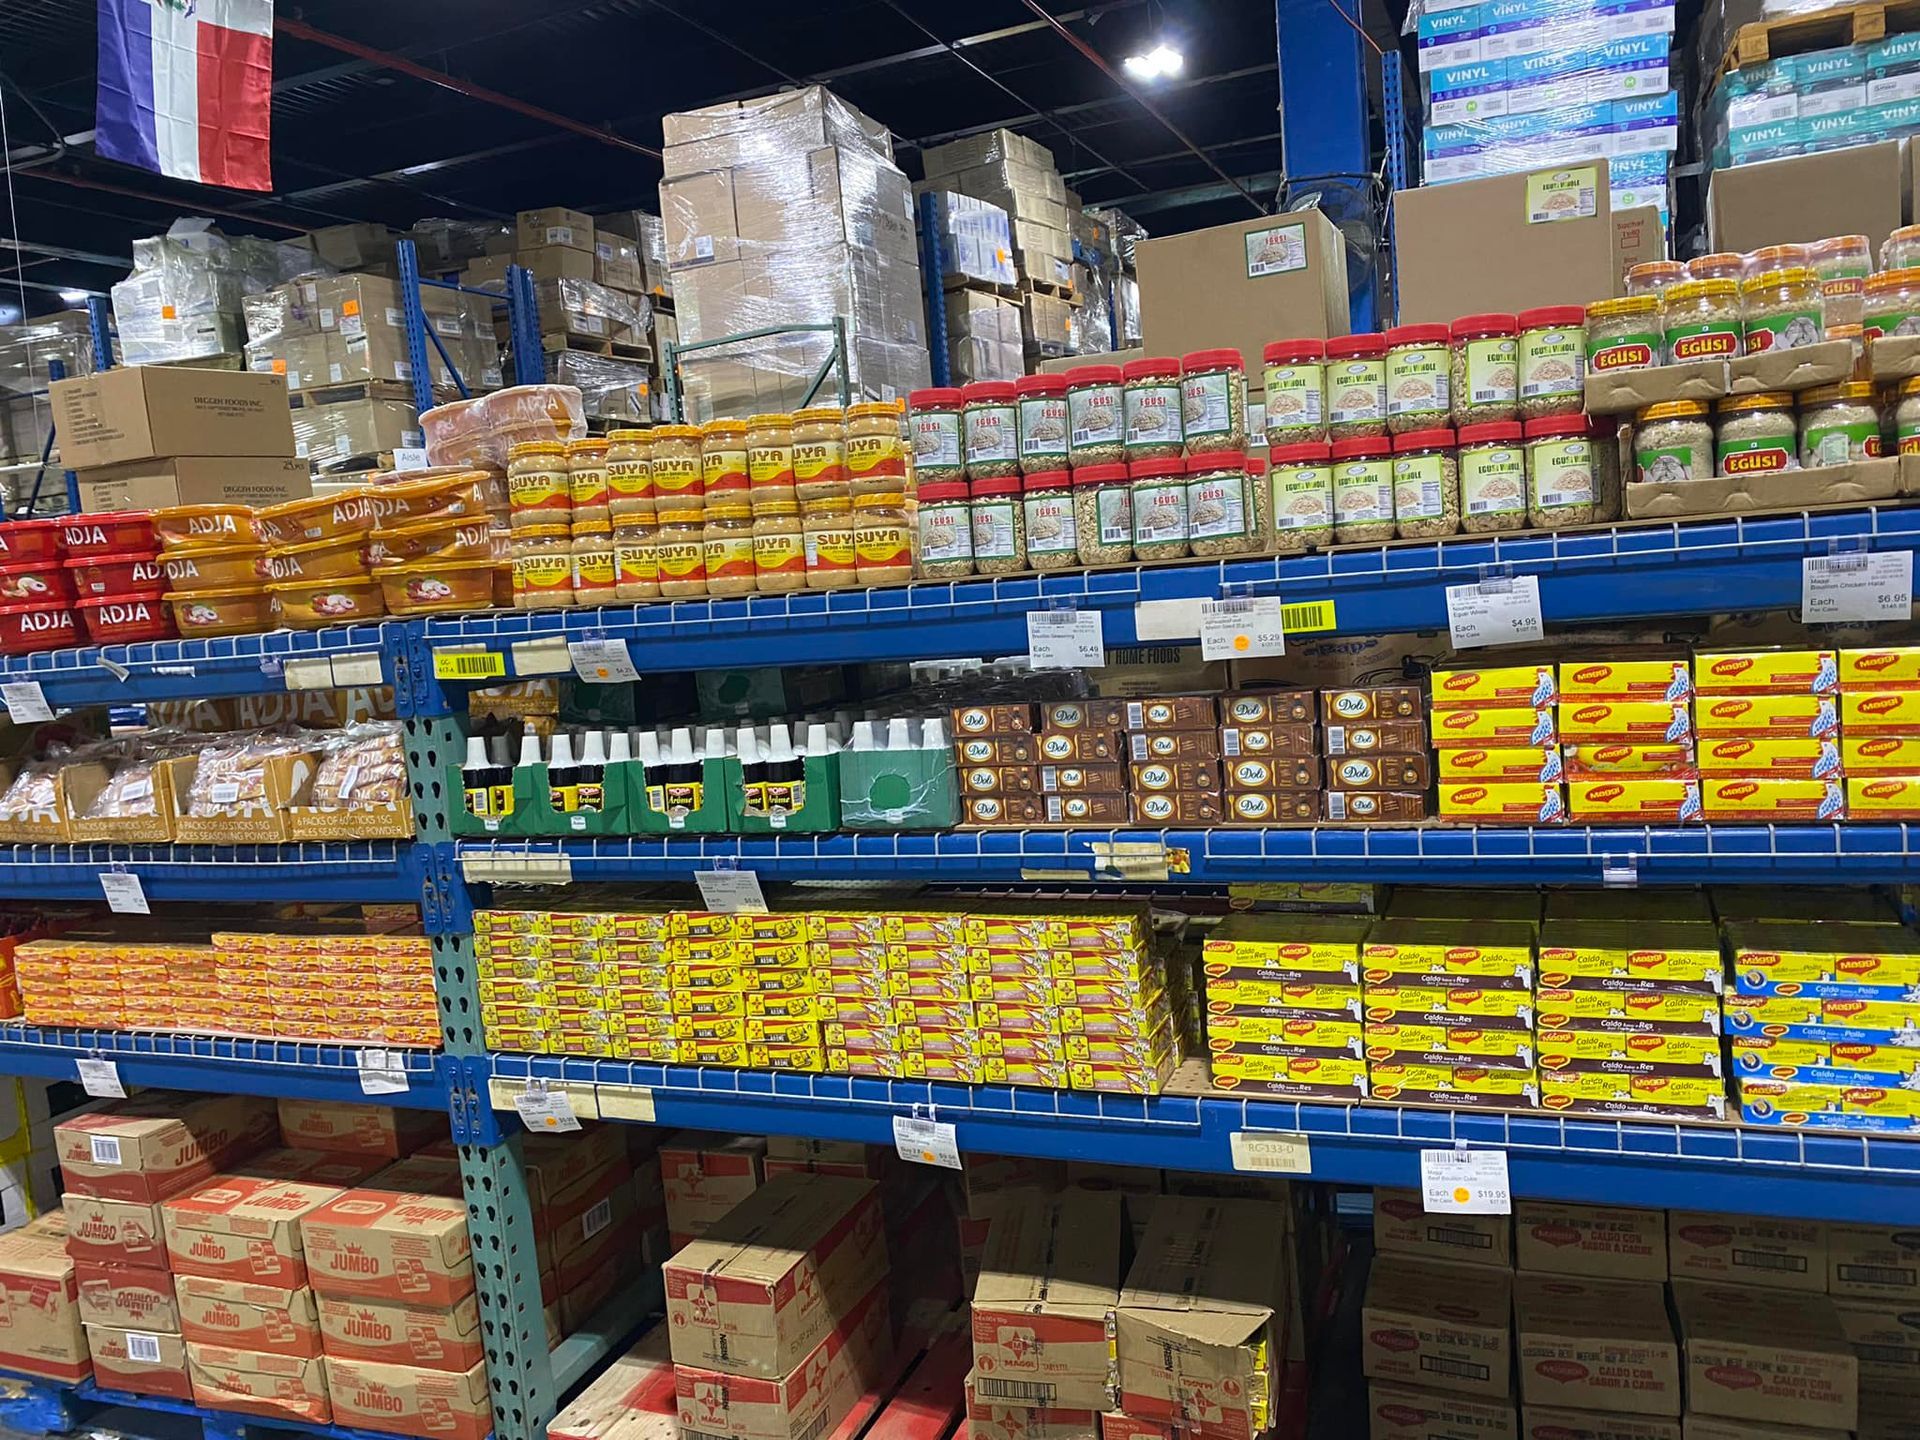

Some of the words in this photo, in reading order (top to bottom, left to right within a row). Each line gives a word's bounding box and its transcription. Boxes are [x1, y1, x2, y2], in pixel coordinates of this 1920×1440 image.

[1493, 2, 1529, 16] VINYL
[1431, 15, 1466, 29] VINYL
[1604, 41, 1650, 56] VINYL
[1807, 58, 1853, 74] VINYL
[1447, 67, 1490, 82] VINYL
[1625, 100, 1663, 112] VINYL
[1811, 116, 1856, 132] VINYL
[1436, 129, 1471, 141] VINYL
[1743, 128, 1785, 143] VINYL
[1680, 338, 1729, 357] EGUSI
[1599, 350, 1644, 368] EGUSI
[225, 398, 247, 406] FOODS
[1089, 396, 1113, 406] EGUSI
[1140, 398, 1166, 406] EGUSI
[608, 464, 649, 476] SUYA
[653, 461, 694, 472] SUYA
[1729, 454, 1779, 472] EGUSI
[1154, 496, 1178, 505] EGUSI
[1199, 489, 1224, 500] EGUSI
[332, 500, 372, 524] ADJA
[1036, 507, 1060, 515] EGUSI
[189, 515, 237, 534] ADJA
[930, 516, 954, 525] EGUSI
[66, 526, 107, 545] ADJA
[454, 525, 491, 549] ADJA
[856, 531, 900, 542] SUYA
[658, 547, 698, 557] SUYA
[524, 558, 566, 568] SUYA
[1811, 598, 1834, 606] Each
[1878, 593, 1907, 603] $6.95
[99, 603, 150, 625] ADJA
[21, 612, 74, 633] ADJA
[1455, 624, 1475, 632] Each
[1512, 618, 1536, 627] $4.95
[1207, 637, 1226, 645] Each
[1258, 634, 1280, 642] $5.29
[1116, 649, 1144, 664] HOME
[1148, 648, 1180, 664] FOODS
[1447, 674, 1477, 690] Maggi
[1577, 669, 1609, 684] Maggi
[1237, 705, 1261, 717] Doli
[1338, 699, 1366, 711] Doli
[1715, 702, 1750, 718] Maggi
[1861, 698, 1900, 714] Maggi
[965, 714, 986, 725] Doli
[1057, 710, 1080, 722] Doli
[969, 744, 990, 756] Doli
[1455, 752, 1485, 767] Maggi
[1145, 772, 1169, 784] Doli
[1239, 768, 1265, 779] Doli
[1343, 767, 1370, 778] Doli
[973, 775, 993, 785] Doli
[1590, 786, 1622, 801] Maggi
[1720, 783, 1756, 799] Maggi
[1863, 781, 1905, 798] Maggi
[250, 832, 279, 840] POWDER
[366, 825, 401, 835] POWDER
[76, 1222, 117, 1243] JUMBO
[189, 1241, 226, 1261] JUMBO
[329, 1251, 380, 1276] JUMBO
[201, 1308, 240, 1329] JUMBO
[342, 1317, 392, 1343] JUMBO
[352, 1388, 403, 1413] JUMBO
